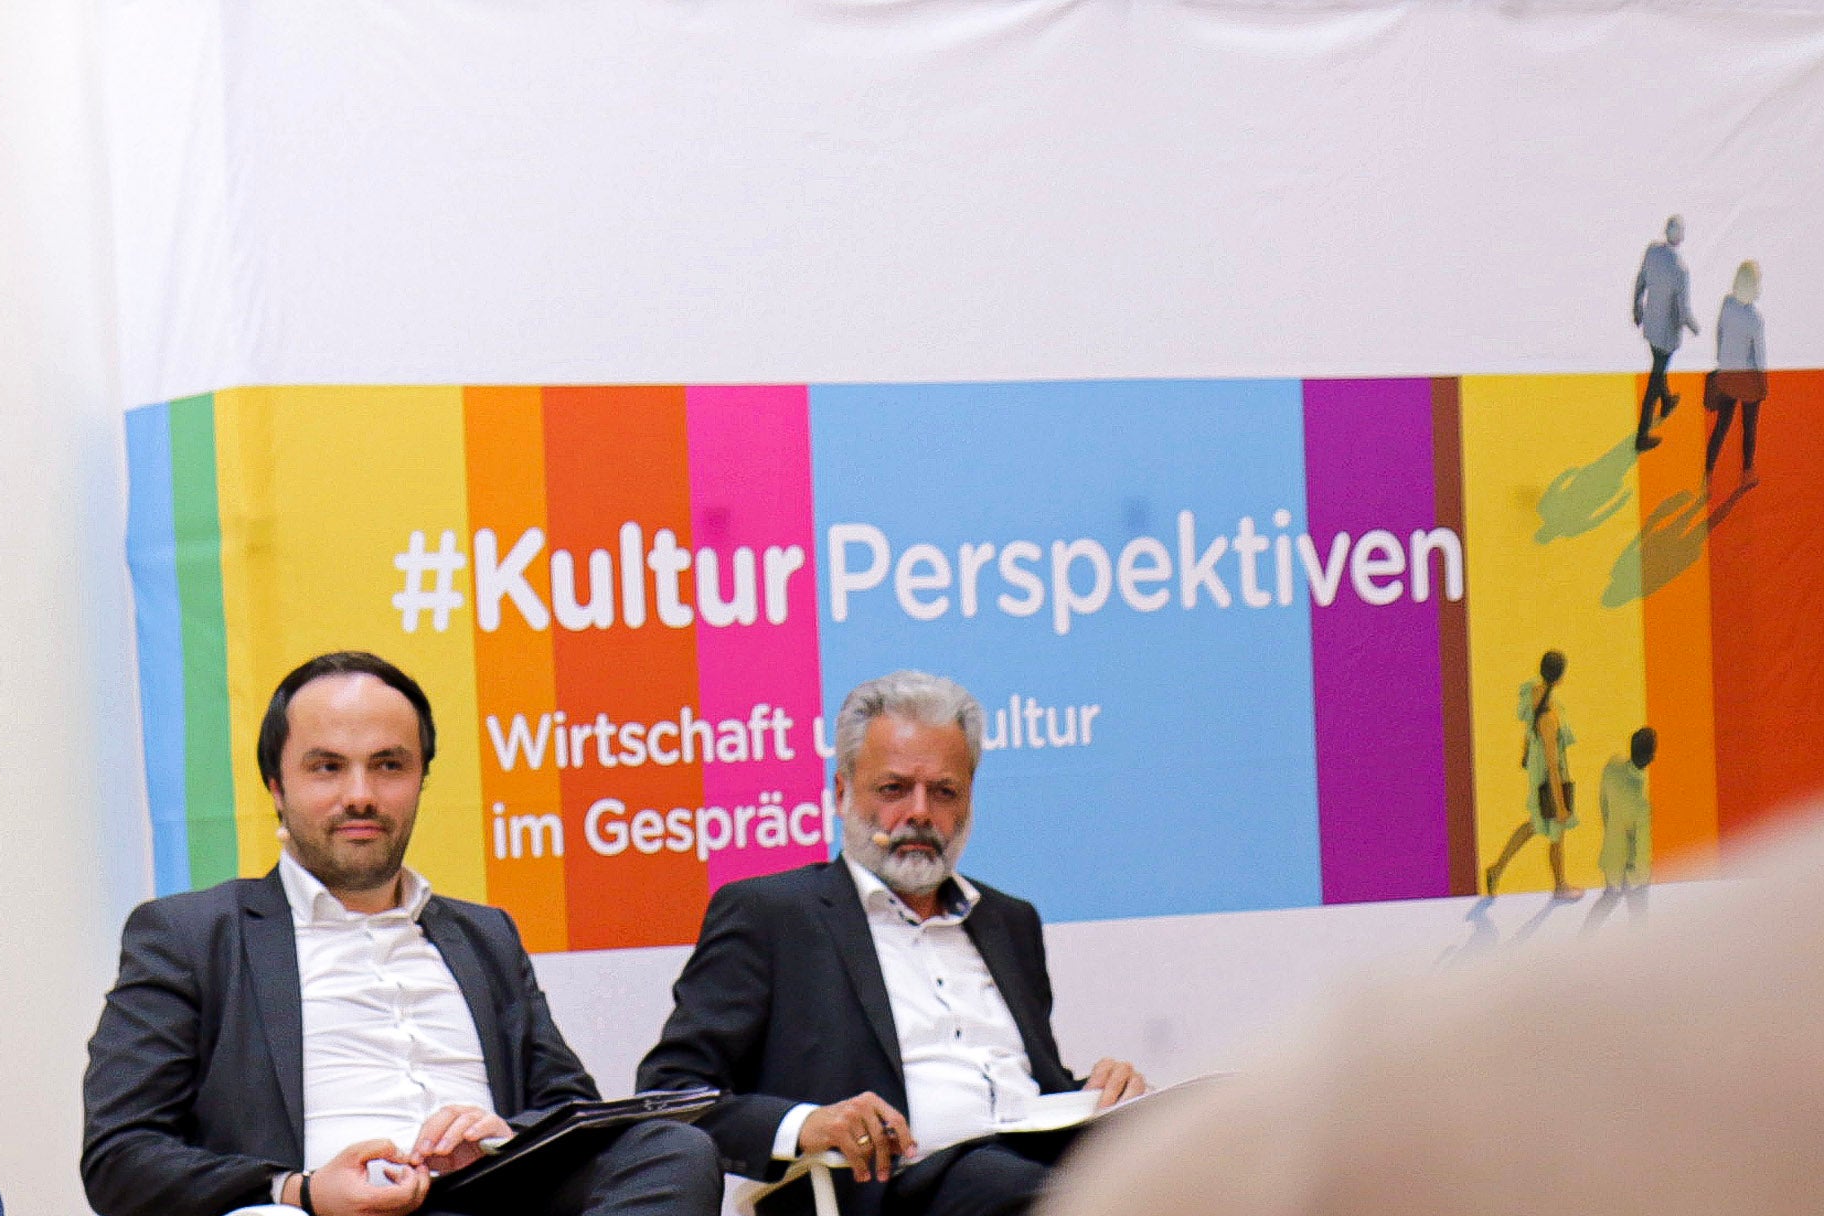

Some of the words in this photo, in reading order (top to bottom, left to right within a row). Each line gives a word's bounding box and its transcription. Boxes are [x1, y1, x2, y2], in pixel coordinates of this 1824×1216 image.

[391, 521, 806, 633] #Kultur
[827, 509, 1464, 636] Perspektiven
[486, 703, 796, 771] Wirtschaft
[982, 693, 1102, 750] ultur
[492, 801, 565, 860] im
